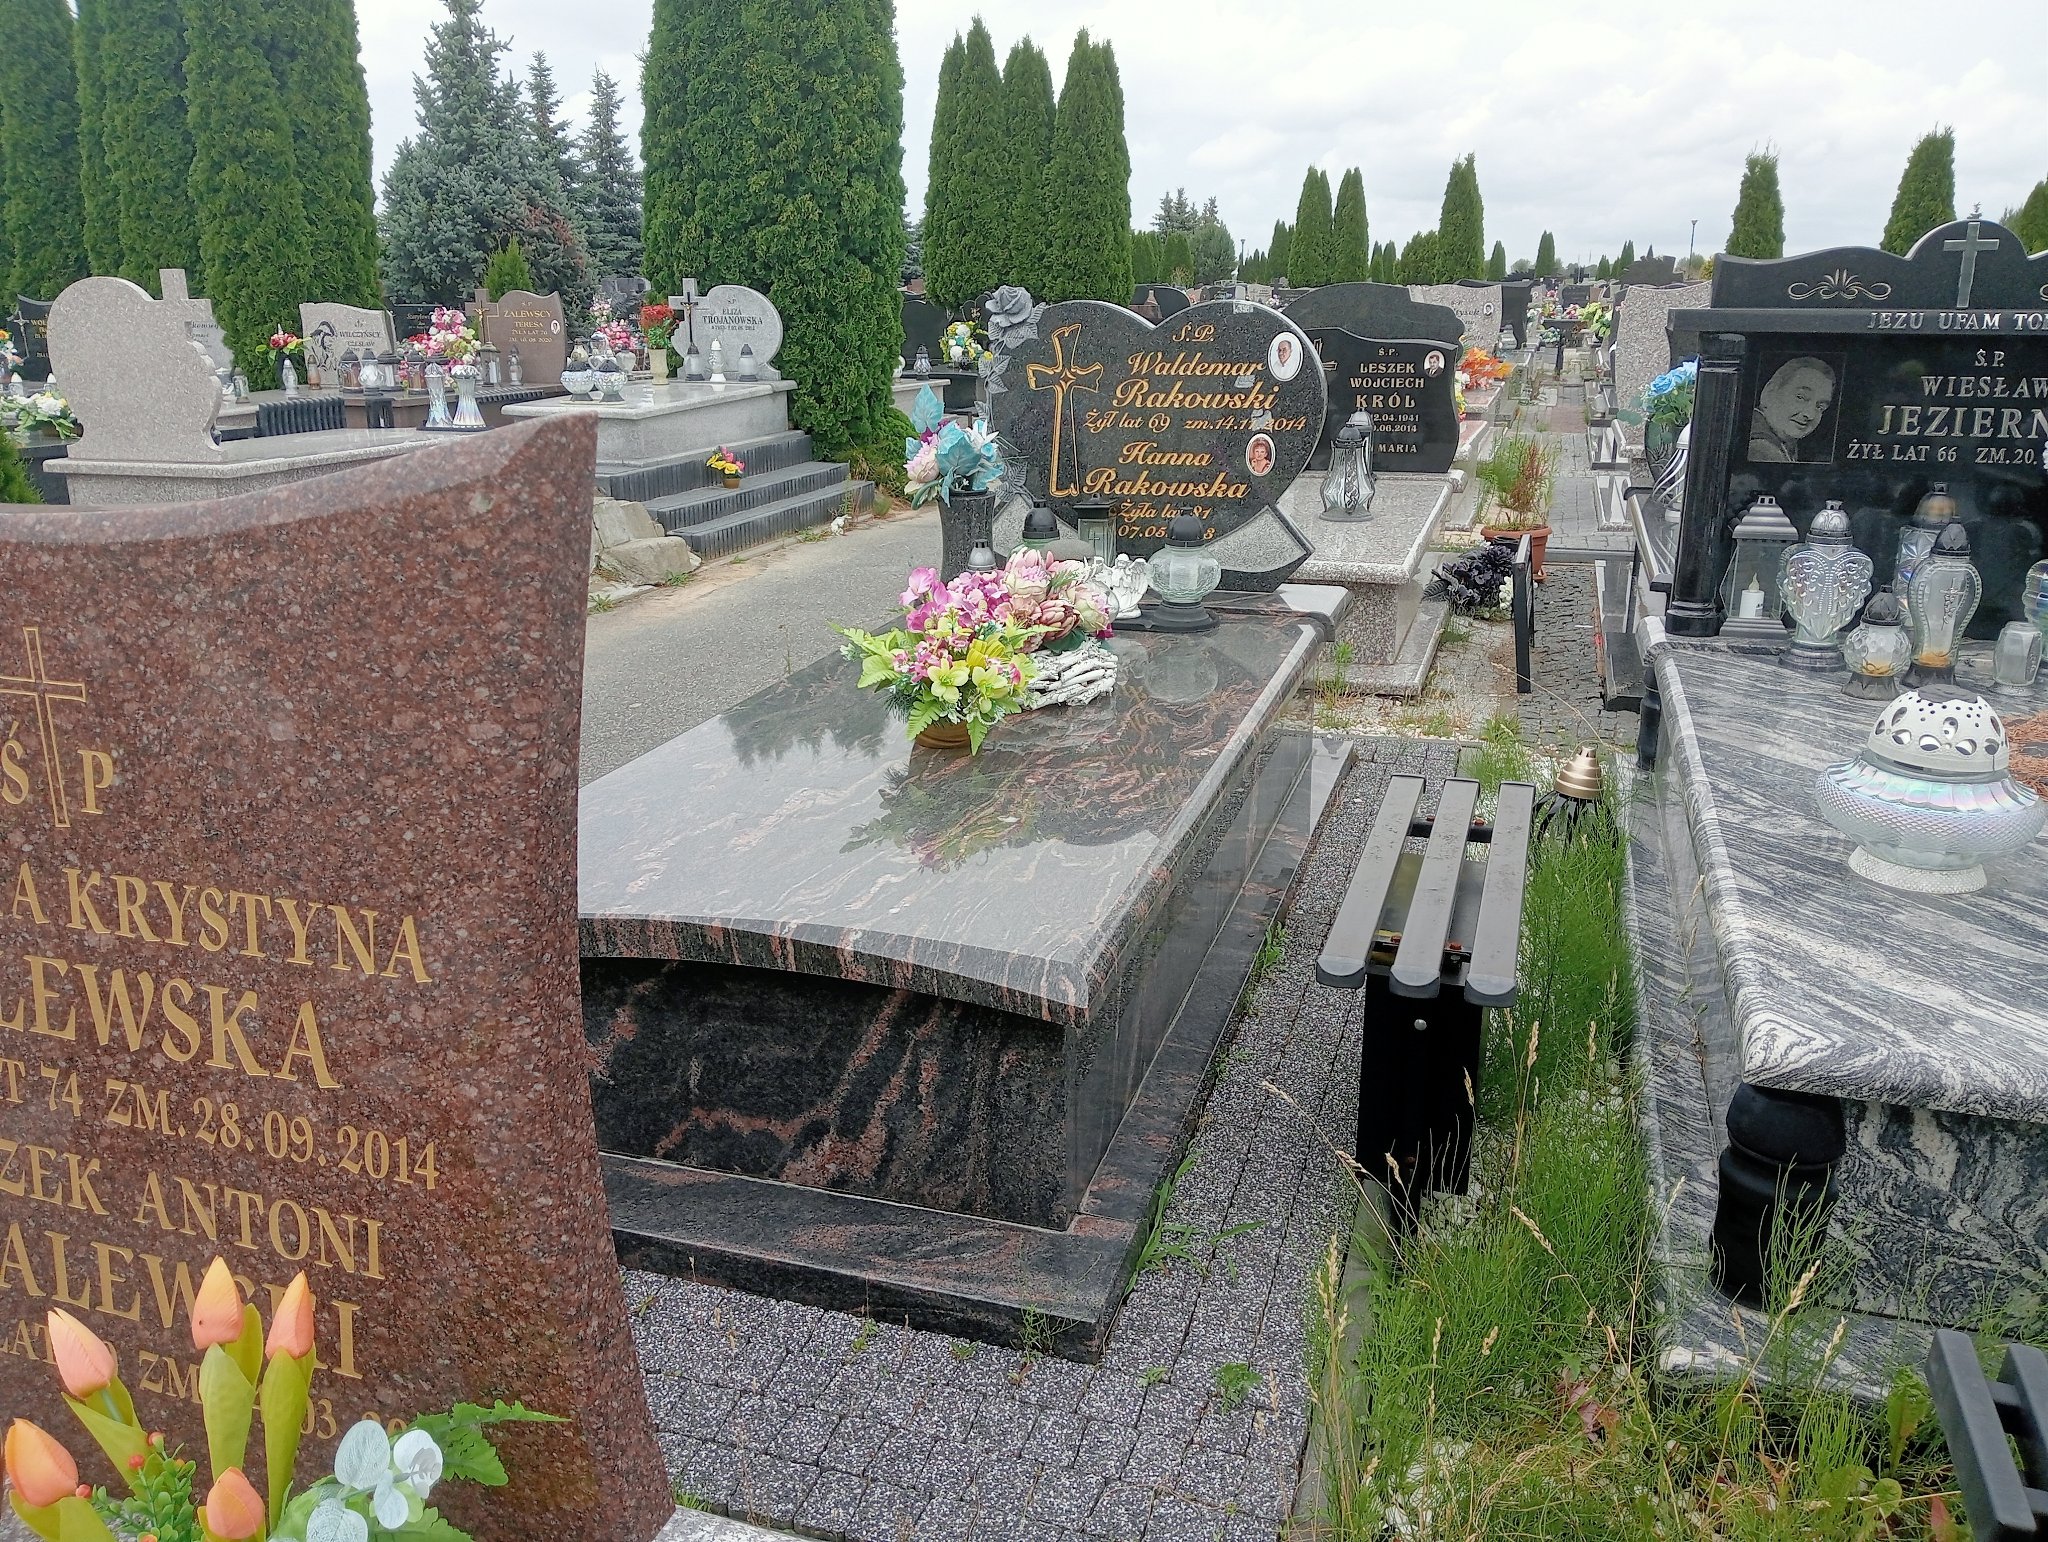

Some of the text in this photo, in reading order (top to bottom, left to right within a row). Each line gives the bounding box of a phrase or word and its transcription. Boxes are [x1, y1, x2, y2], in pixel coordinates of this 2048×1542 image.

[504, 310, 551, 318] ZALEWSCY
[703, 316, 763, 325] TROJANOWSKA
[1867, 312, 1925, 329] JEZU
[1938, 312, 2001, 330] UFAM
[1128, 350, 1267, 377] Waldemar
[1360, 362, 1416, 374] LESZEK
[1112, 378, 1280, 410] Rakowski
[1350, 377, 1425, 388] WOJCIECH
[1355, 392, 1416, 409] KRÓL
[1118, 412, 1143, 429] lat
[1148, 411, 1171, 432] 69
[1118, 441, 1214, 466] Hanna
[1378, 443, 1418, 453] MARIA
[1847, 438, 1885, 460] ŻYŁ
[1892, 444, 1930, 461] LAT
[1937, 446, 1959, 462] 66
[1083, 468, 1251, 499] Rakowska
[1118, 498, 1159, 523] Żyła
[77, 748, 115, 815] P
[62, 867, 432, 984] KRYSTYNA
[40, 1060, 84, 1118] 74
[133, 1170, 387, 1281] ANTONI
